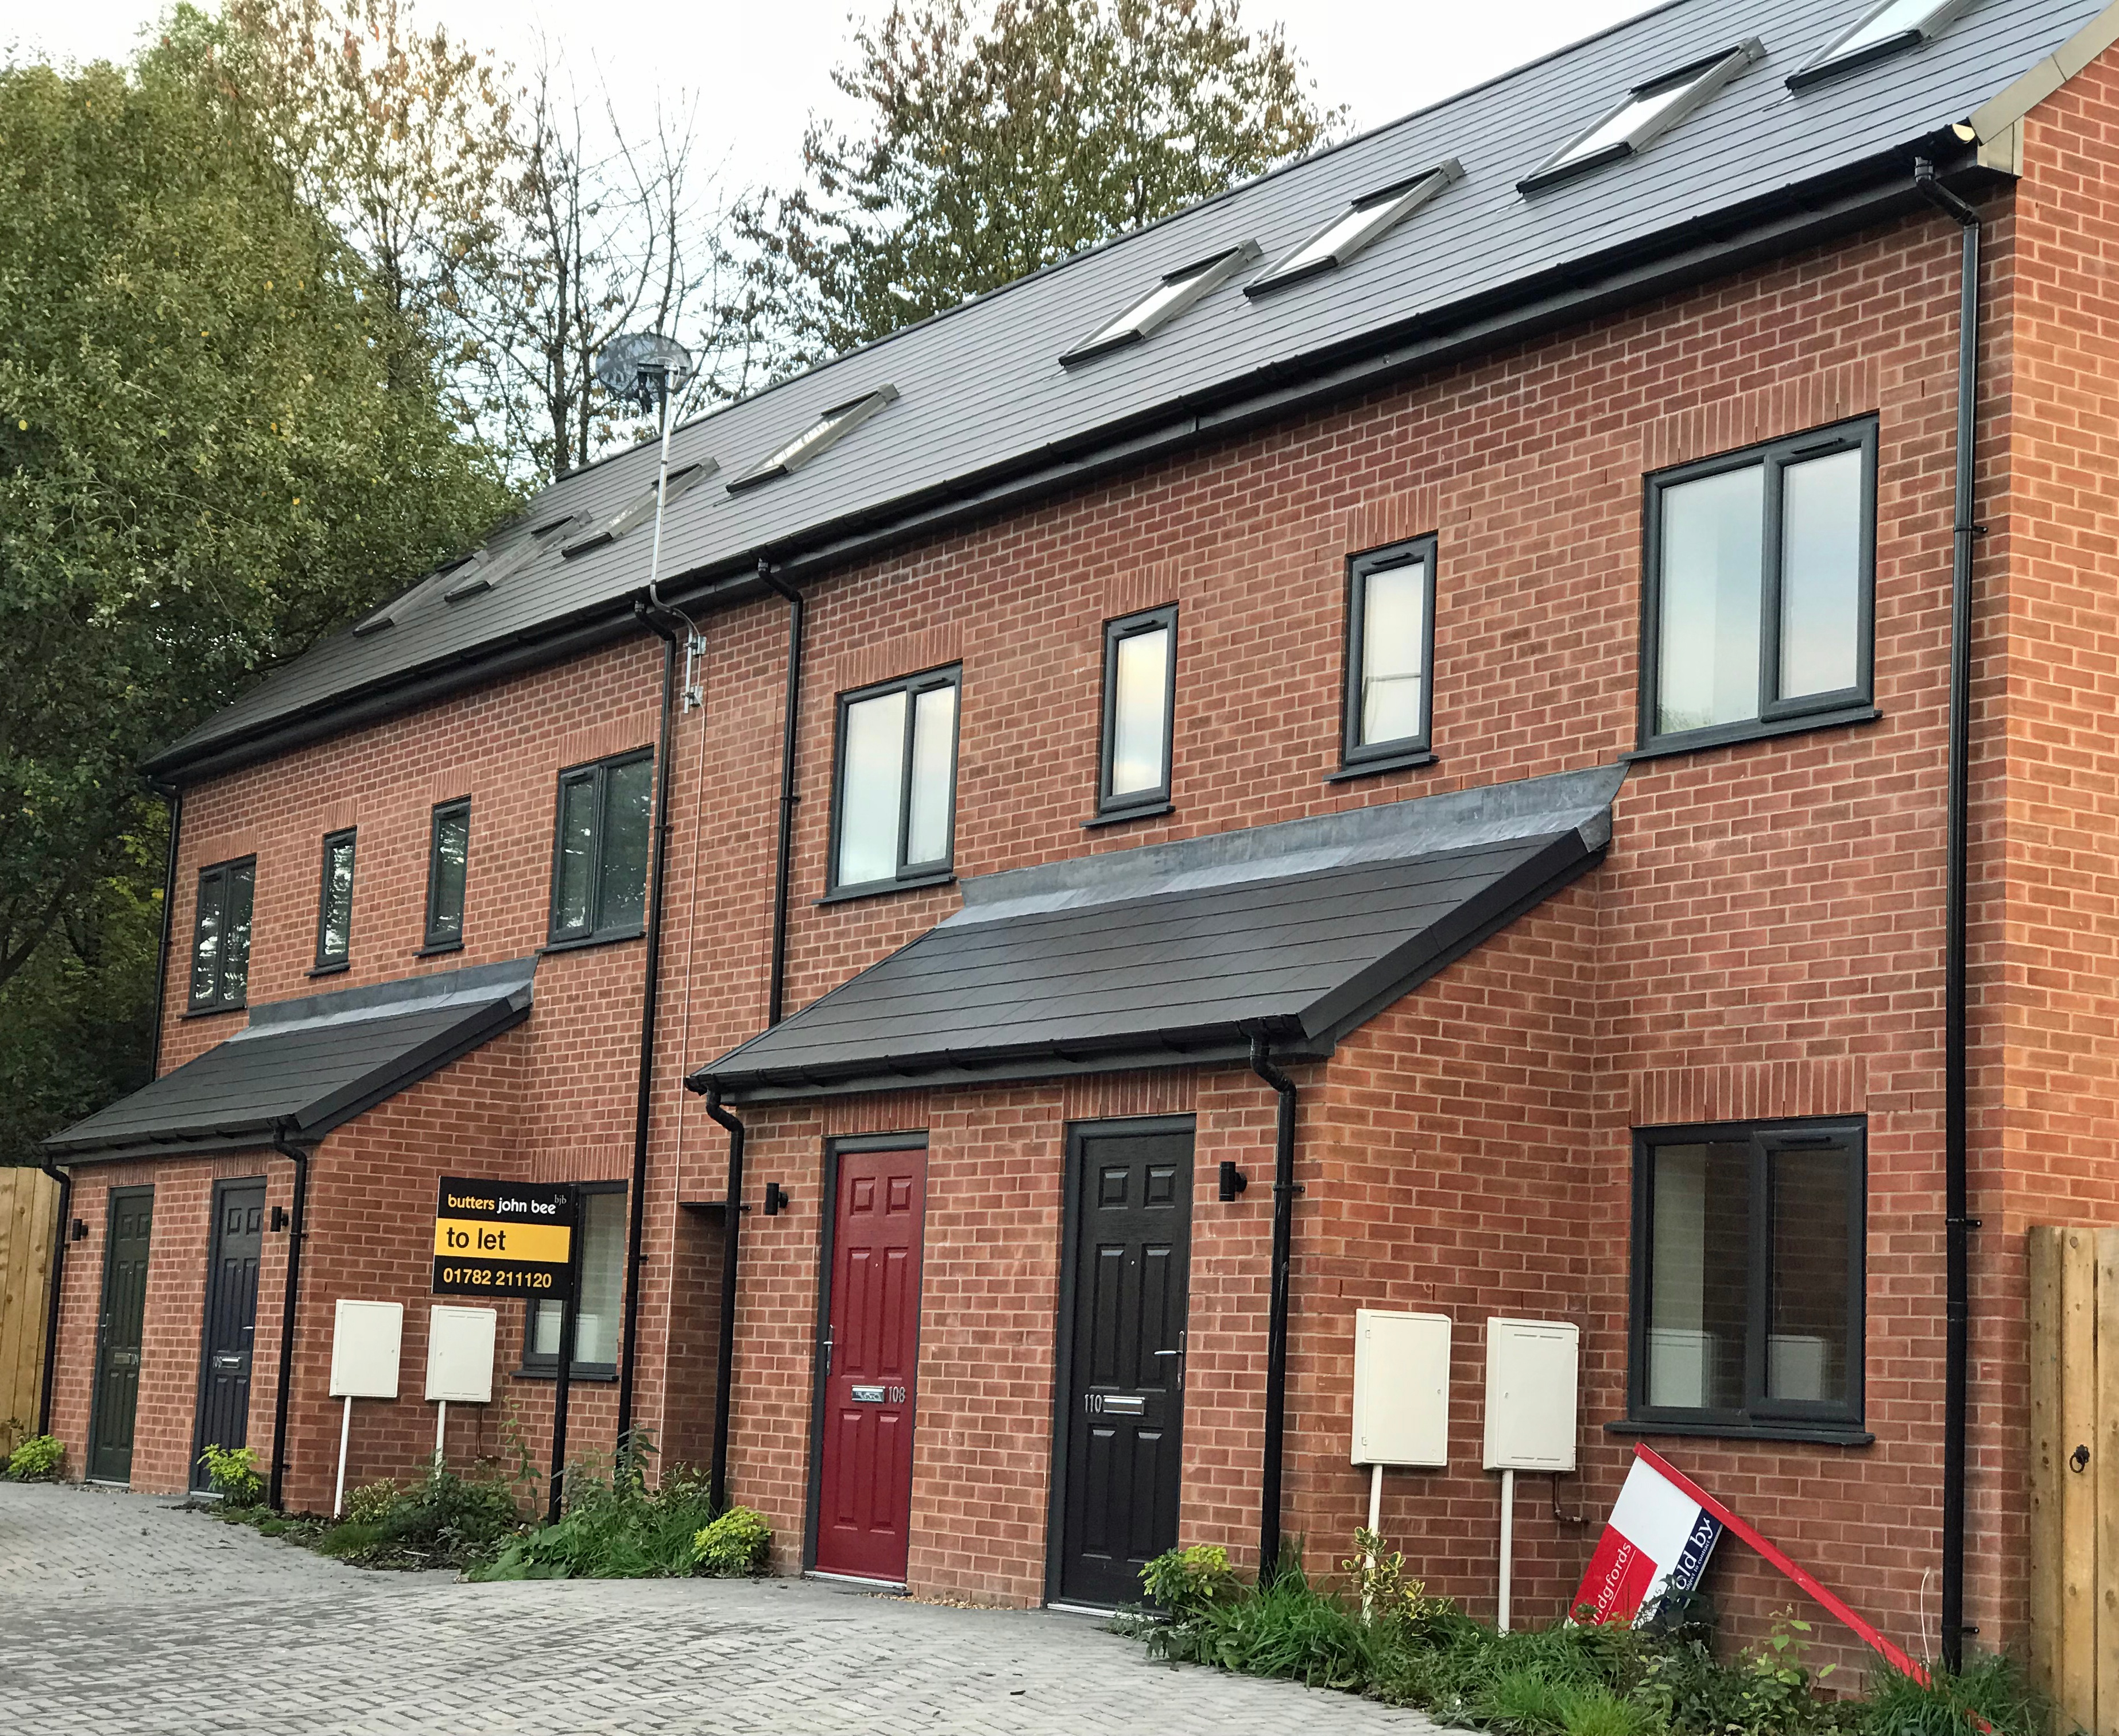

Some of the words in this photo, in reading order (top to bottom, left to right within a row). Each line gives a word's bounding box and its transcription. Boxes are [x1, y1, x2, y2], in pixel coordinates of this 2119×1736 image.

[448, 1194, 495, 1210] butters
[497, 1198, 527, 1214] john
[531, 1200, 556, 1215] bee
[555, 1194, 567, 1206] bjb
[447, 1227, 470, 1249] to
[477, 1227, 506, 1251] let
[443, 1268, 491, 1285] 01782
[495, 1270, 552, 1288] 211120
[889, 1386, 906, 1404] 108
[1084, 1394, 1102, 1413] 110
[1668, 1550, 1698, 1601] old
[1689, 1517, 1714, 1548] by
[1684, 1572, 1696, 1591] ubject
[1698, 1540, 1710, 1564] contract
